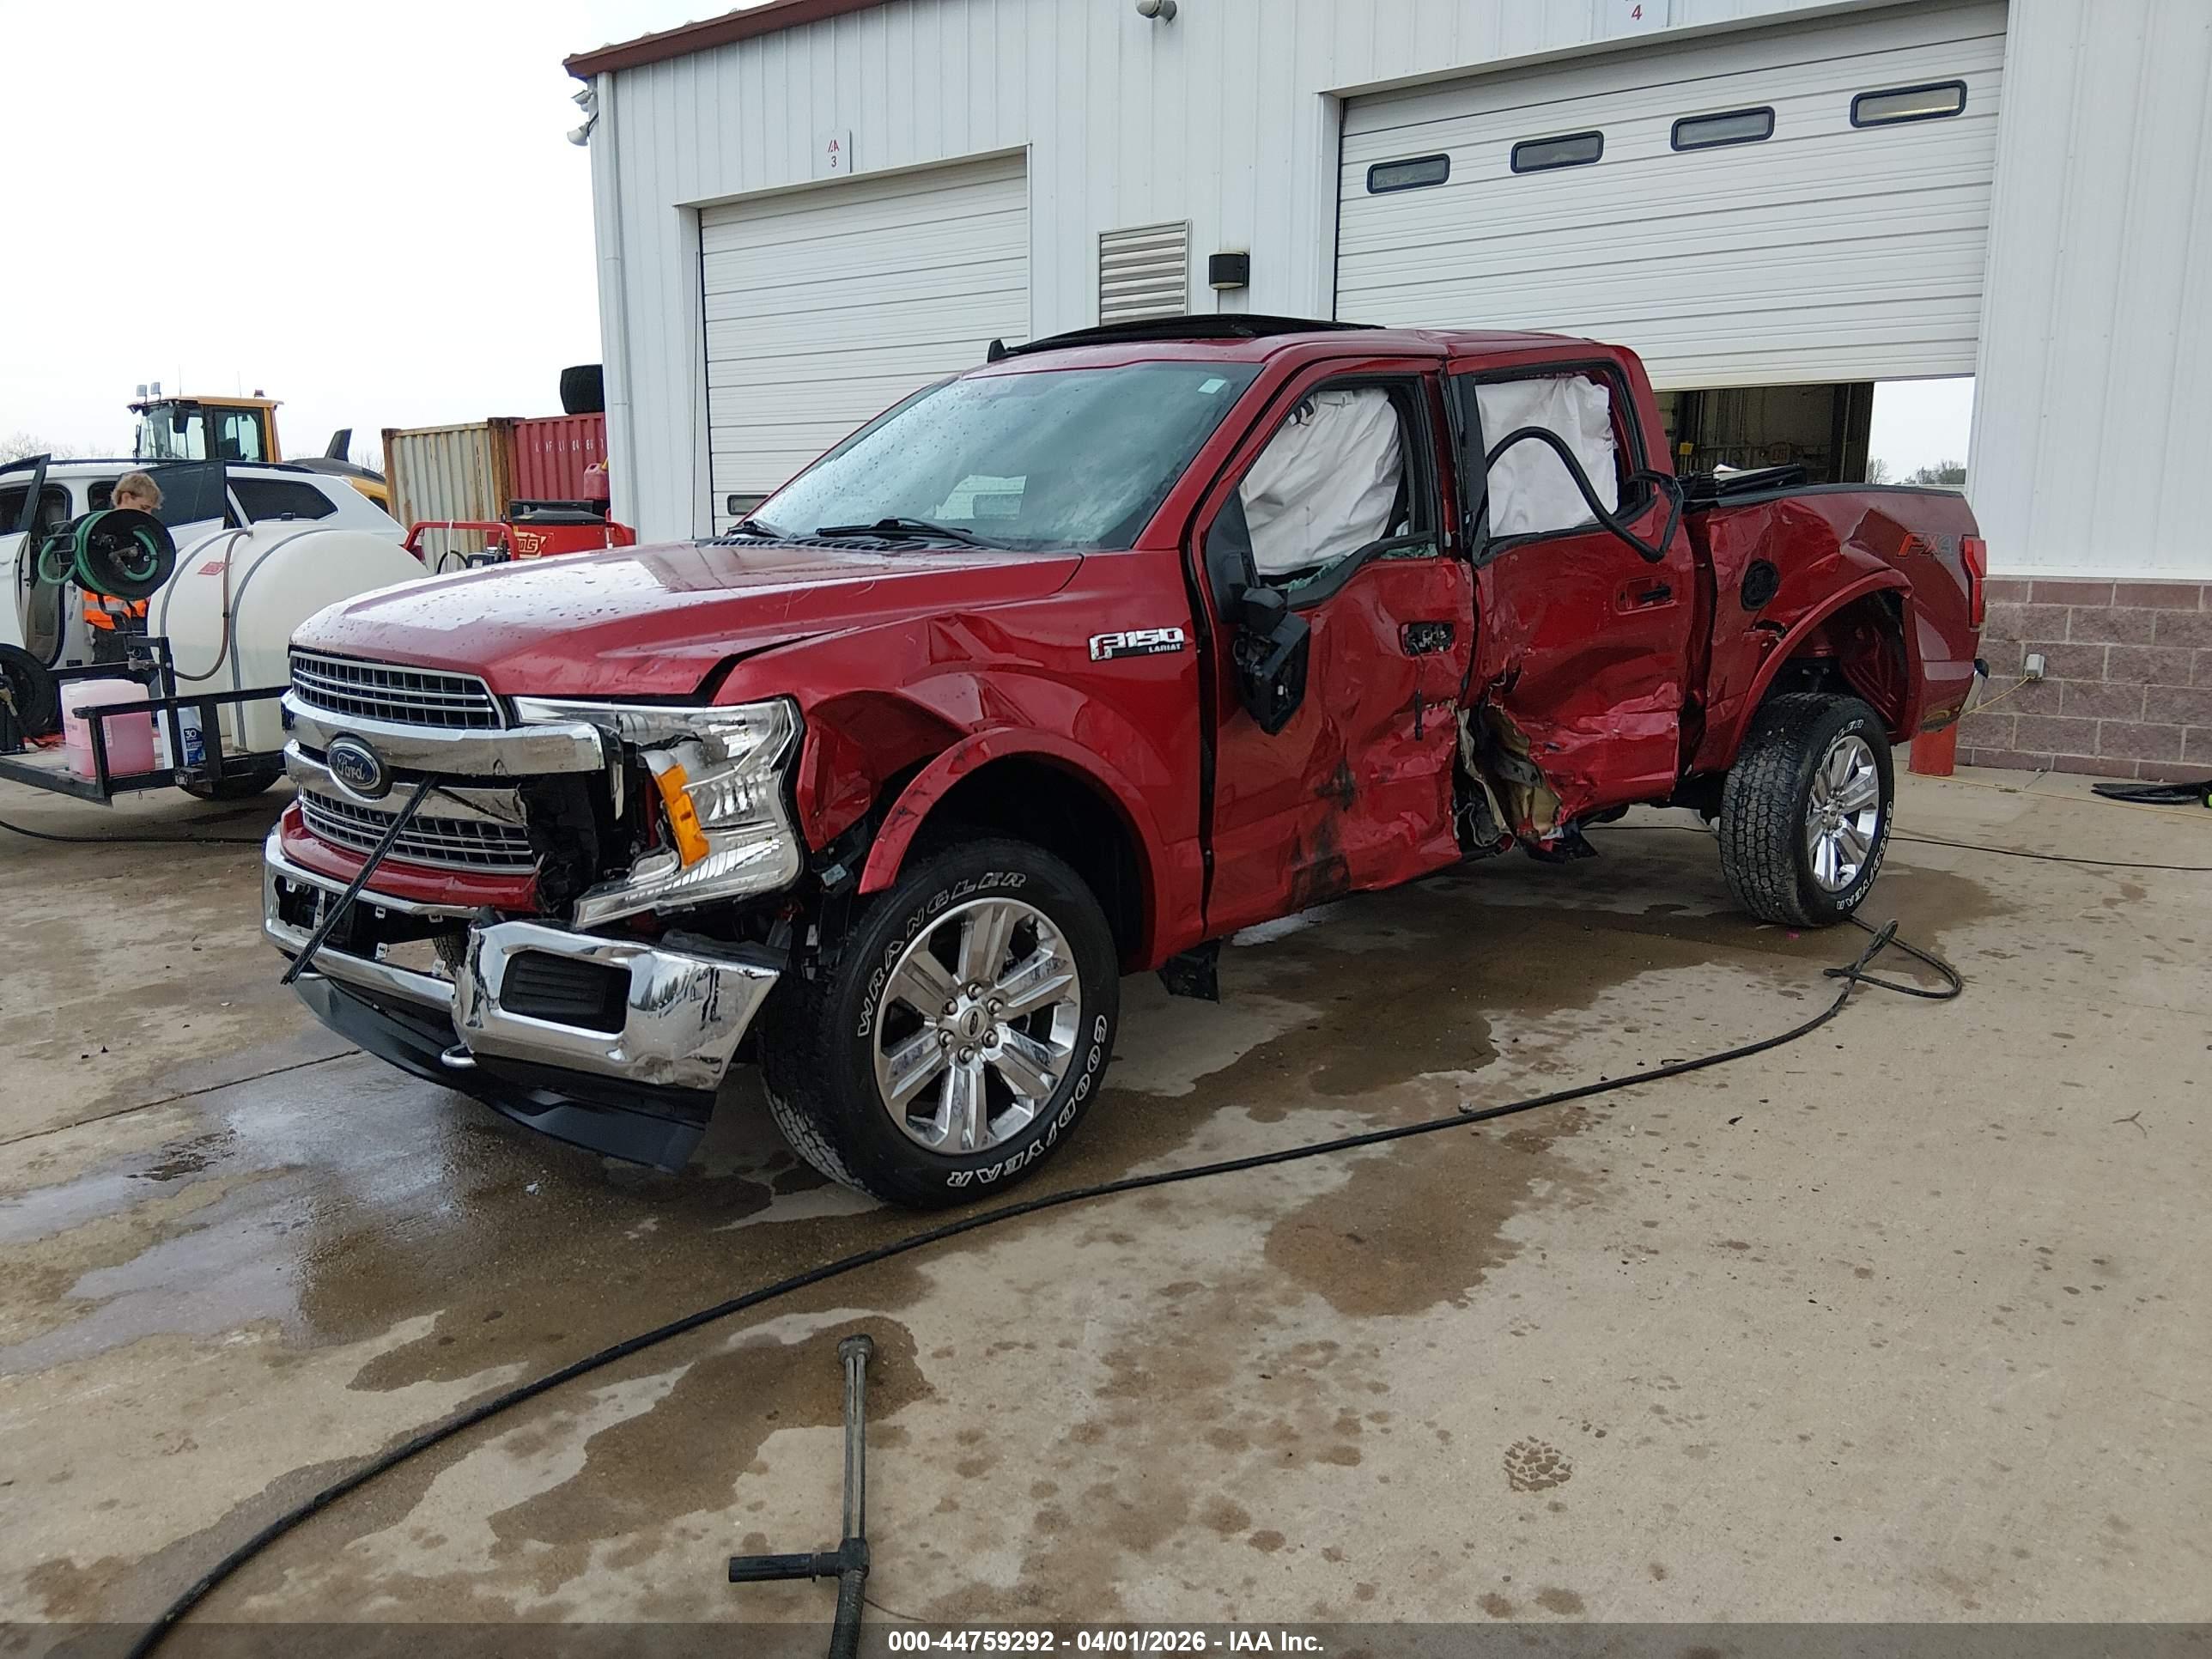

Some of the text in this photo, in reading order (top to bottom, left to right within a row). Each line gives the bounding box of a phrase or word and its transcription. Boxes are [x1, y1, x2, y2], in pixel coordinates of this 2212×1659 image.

[1631, 3, 1643, 21] 4
[830, 155, 837, 167] 3
[1148, 644, 1182, 653] LARIAT
[185, 729, 197, 738] 30
[337, 752, 365, 780] Ford
[1836, 800, 1893, 910] GOODYEAR
[857, 872, 1027, 1038] WRANGLER
[947, 1013, 1108, 1187] GOODYEAR
